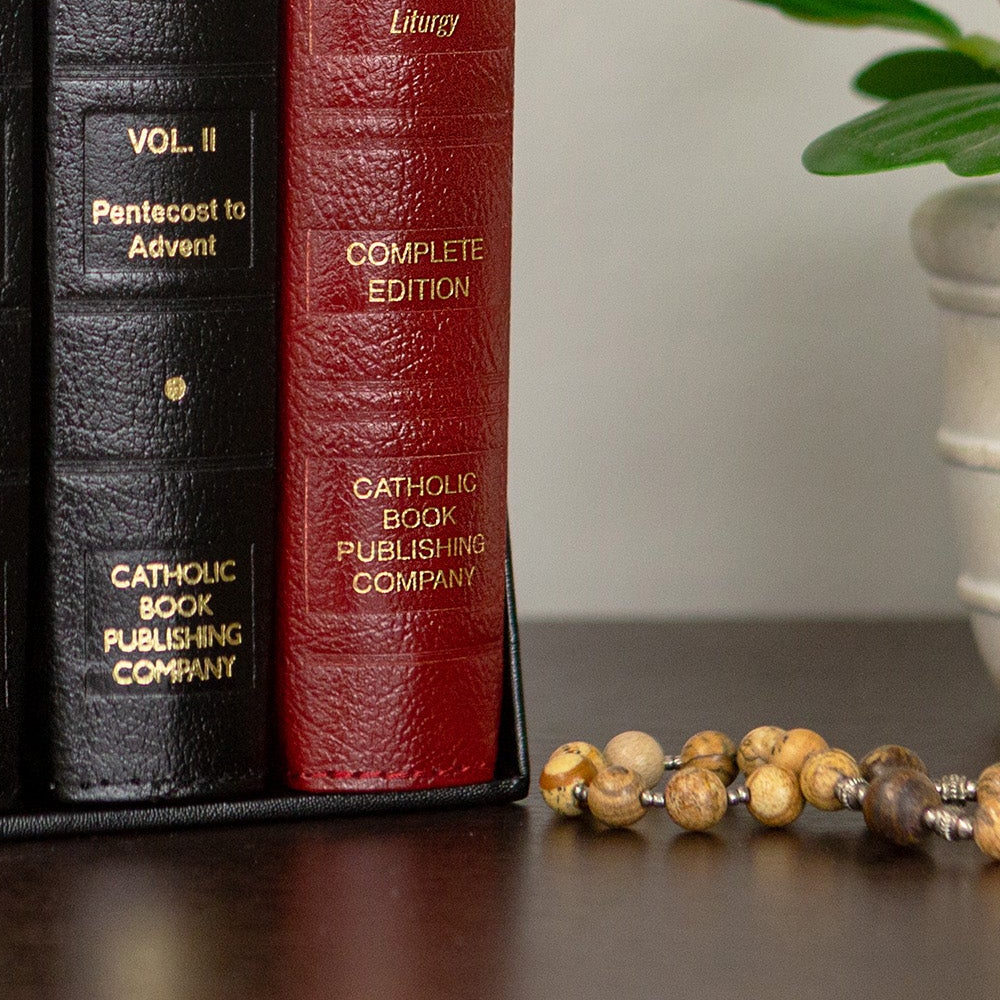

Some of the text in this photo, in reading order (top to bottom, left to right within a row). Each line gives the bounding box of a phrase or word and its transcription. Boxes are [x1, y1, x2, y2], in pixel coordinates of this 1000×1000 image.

[389, 8, 460, 38] Liturgy
[127, 126, 216, 154] VOL. II
[92, 198, 246, 225] Pentecost to
[128, 234, 217, 260] Advent
[346, 238, 484, 266] COMPLETE
[368, 276, 470, 303] EDITION
[353, 472, 477, 500] CATHOLIC
[383, 506, 457, 530] BOOK
[336, 533, 486, 563] PUBLISHING
[110, 559, 237, 589] CATHOLIC
[352, 566, 476, 594] COMPANY
[139, 593, 214, 621] BOOK
[103, 622, 242, 654] PUBLISHING
[112, 655, 237, 686] COMPANY
